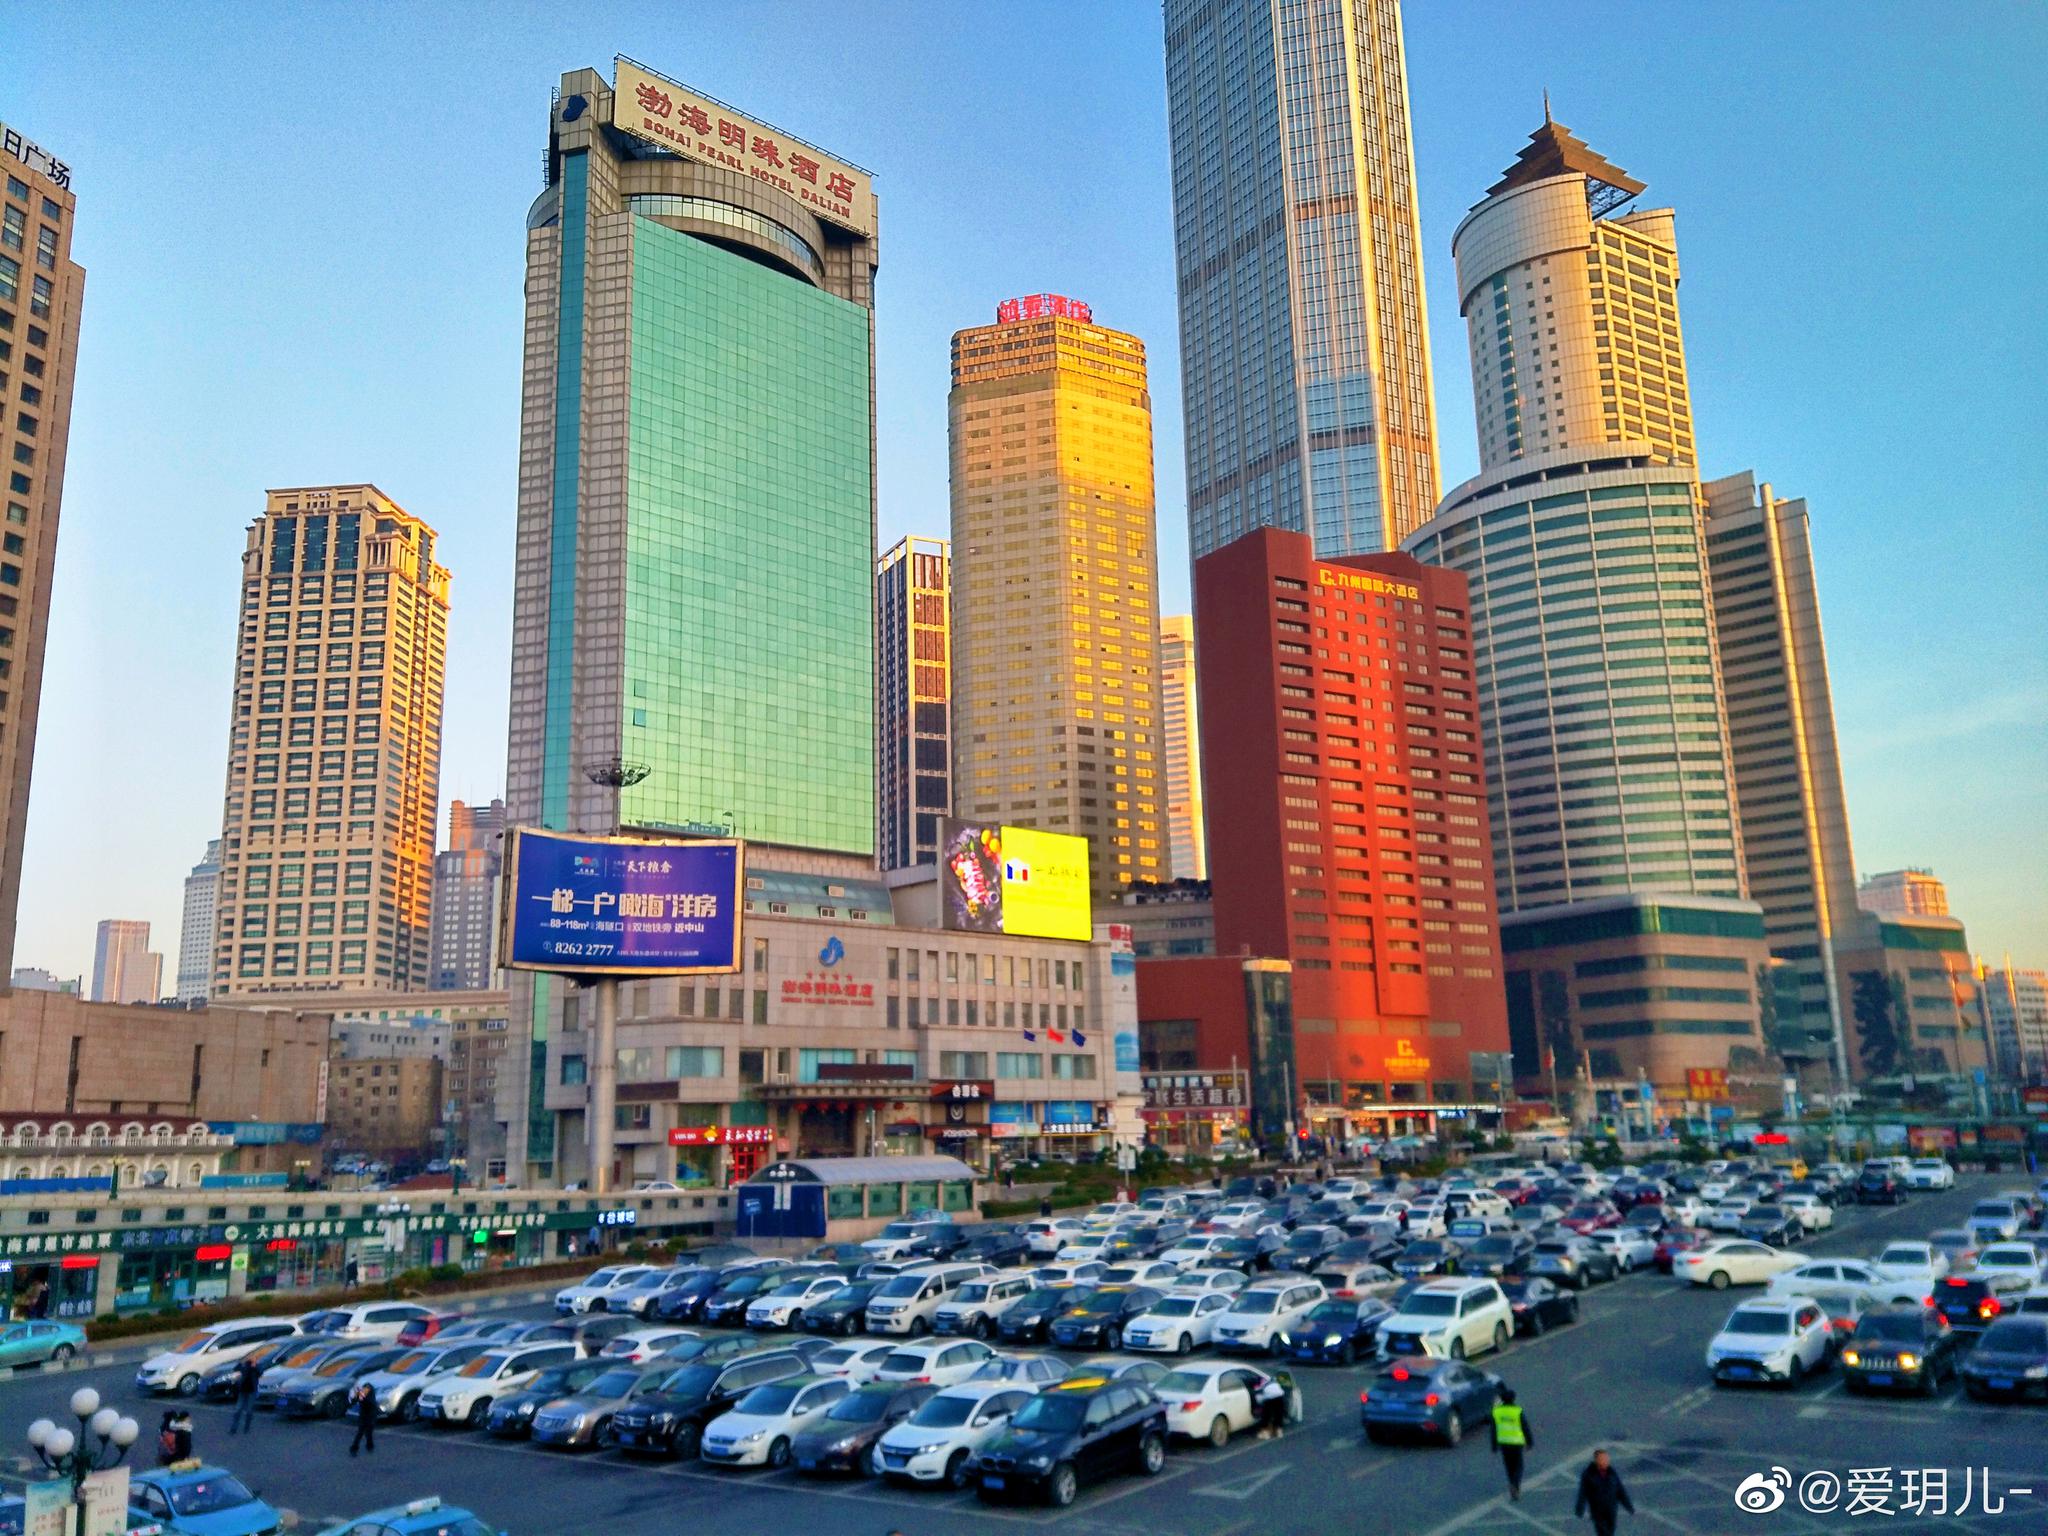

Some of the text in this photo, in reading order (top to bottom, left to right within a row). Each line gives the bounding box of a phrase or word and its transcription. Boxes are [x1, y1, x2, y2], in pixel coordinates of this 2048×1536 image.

[636, 82, 856, 203] 渤海明珠酒店
[643, 117, 850, 219] BOHAI PEARL HOTEL DALIAN
[555, 942, 582, 955] 8262
[585, 944, 614, 956] 2777
